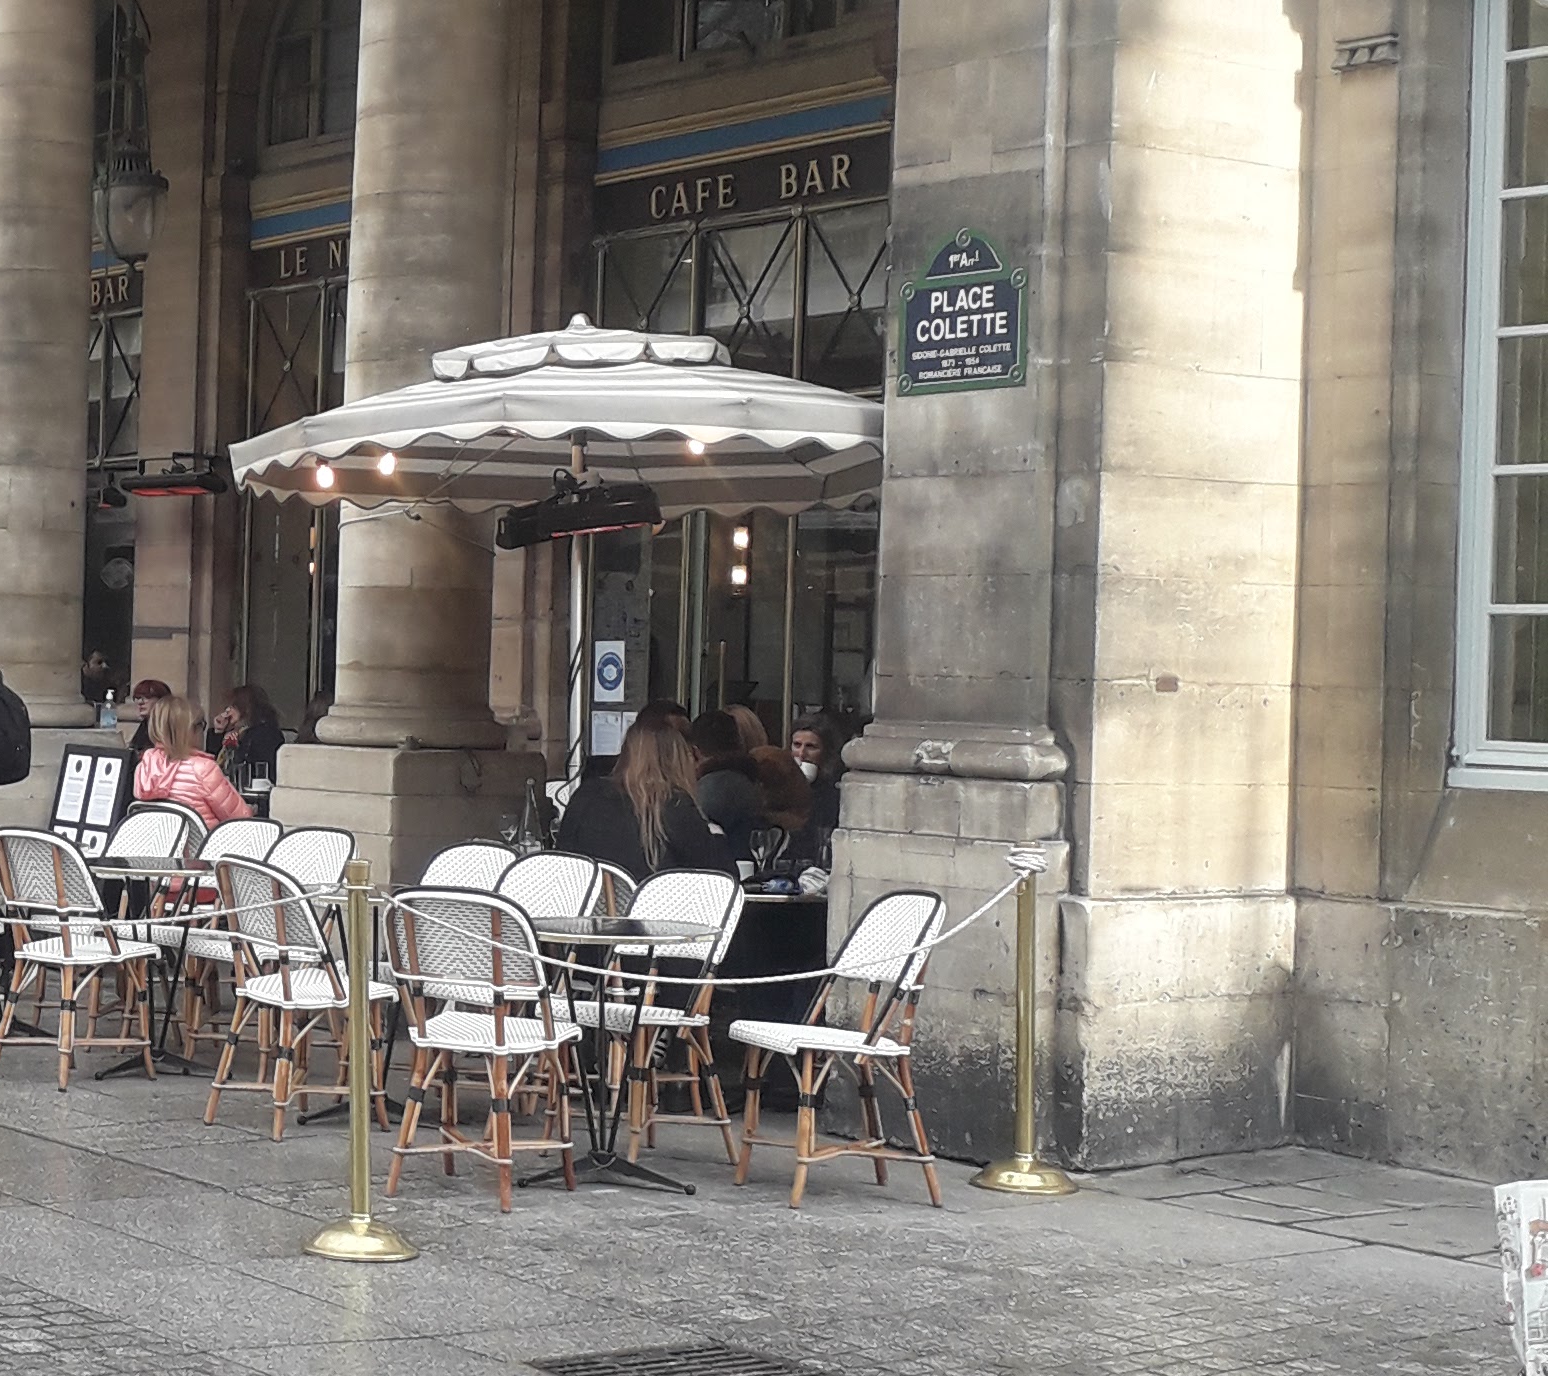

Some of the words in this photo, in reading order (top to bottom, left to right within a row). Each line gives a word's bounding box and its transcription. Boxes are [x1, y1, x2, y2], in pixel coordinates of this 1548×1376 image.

[650, 175, 736, 219] CAFE
[780, 154, 851, 199] BAR
[280, 247, 308, 279] LE
[328, 240, 350, 270] N
[91, 275, 130, 306] BAR
[930, 285, 995, 314] PLACE
[916, 311, 1008, 343] COLETTE
[979, 343, 1011, 353] COLETTE
